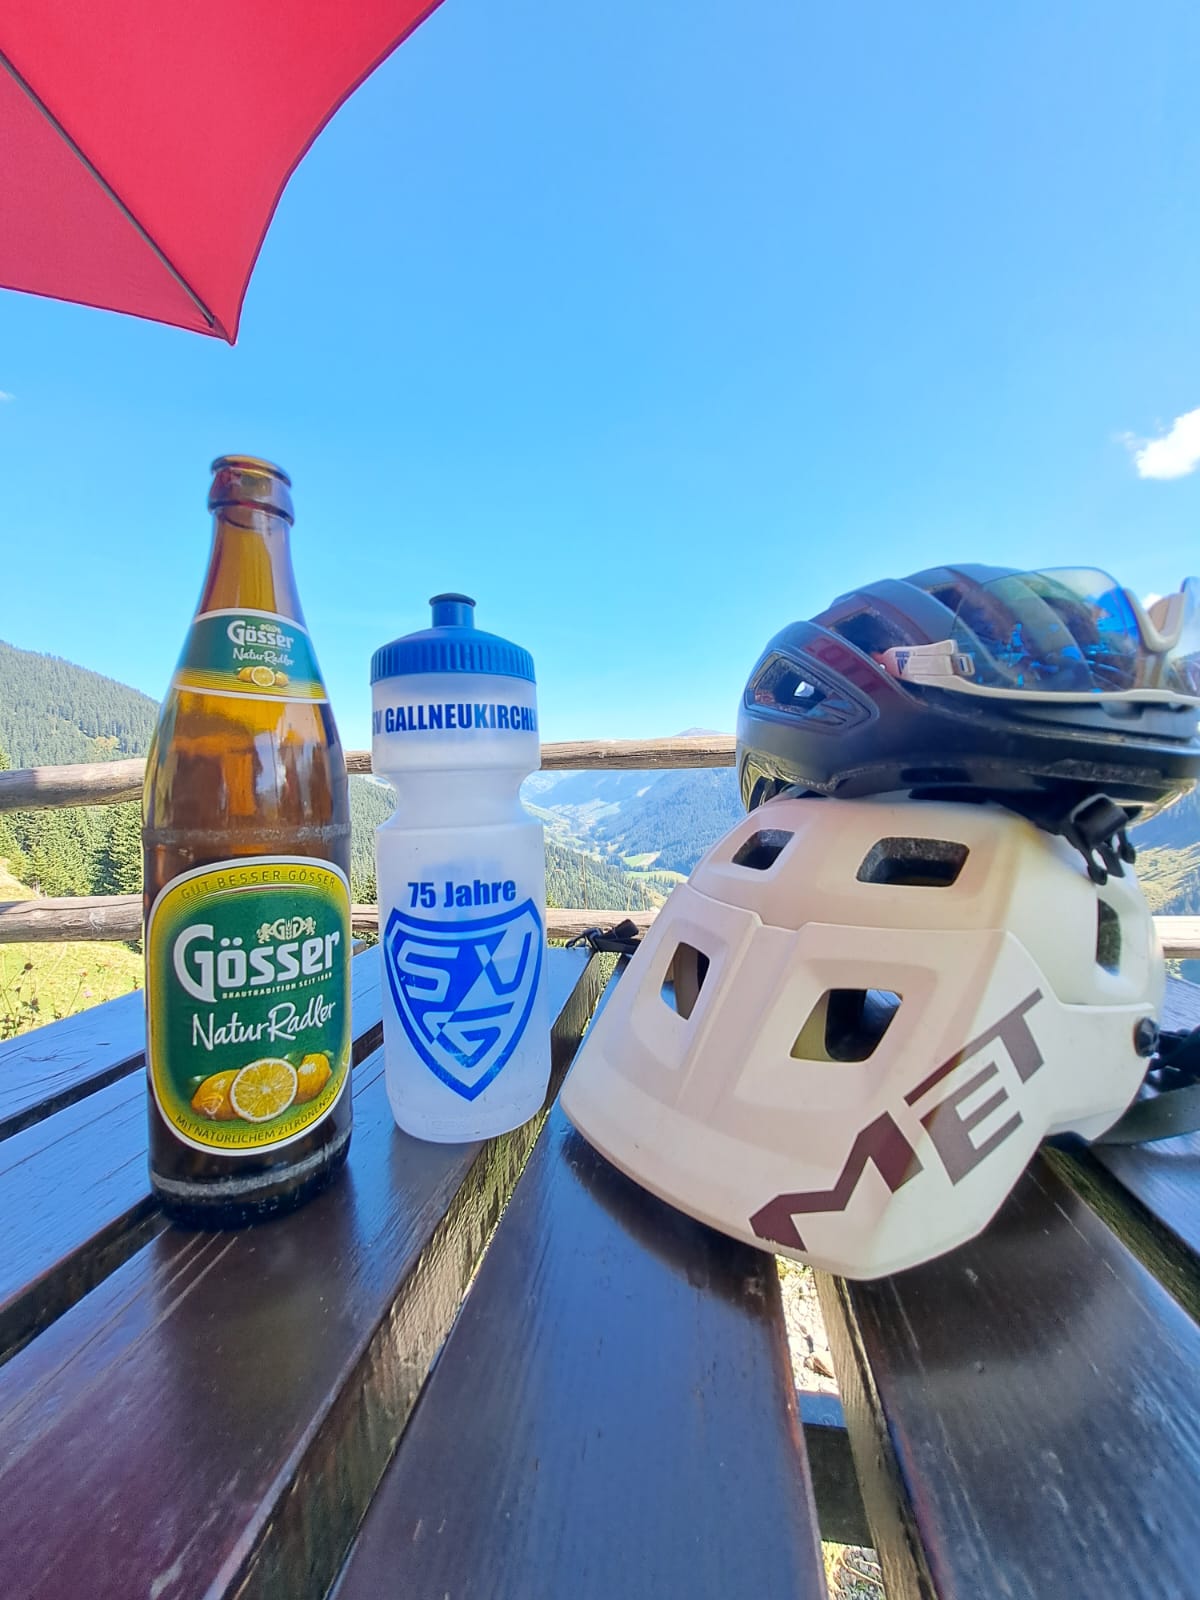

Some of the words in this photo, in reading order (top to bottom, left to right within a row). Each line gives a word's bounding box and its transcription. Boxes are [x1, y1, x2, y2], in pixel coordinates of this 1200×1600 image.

[227, 620, 294, 649] Gösser
[385, 703, 537, 734] GALLNEUKIRCH
[181, 881, 210, 899] GUT
[217, 870, 281, 889] BESSER
[288, 869, 336, 888] GÖSSER
[407, 881, 437, 909] 75
[443, 879, 517, 908] Jahre
[173, 924, 340, 1003] Gösser
[175, 1114, 193, 1131] MIT
[749, 987, 1045, 1253] MET
